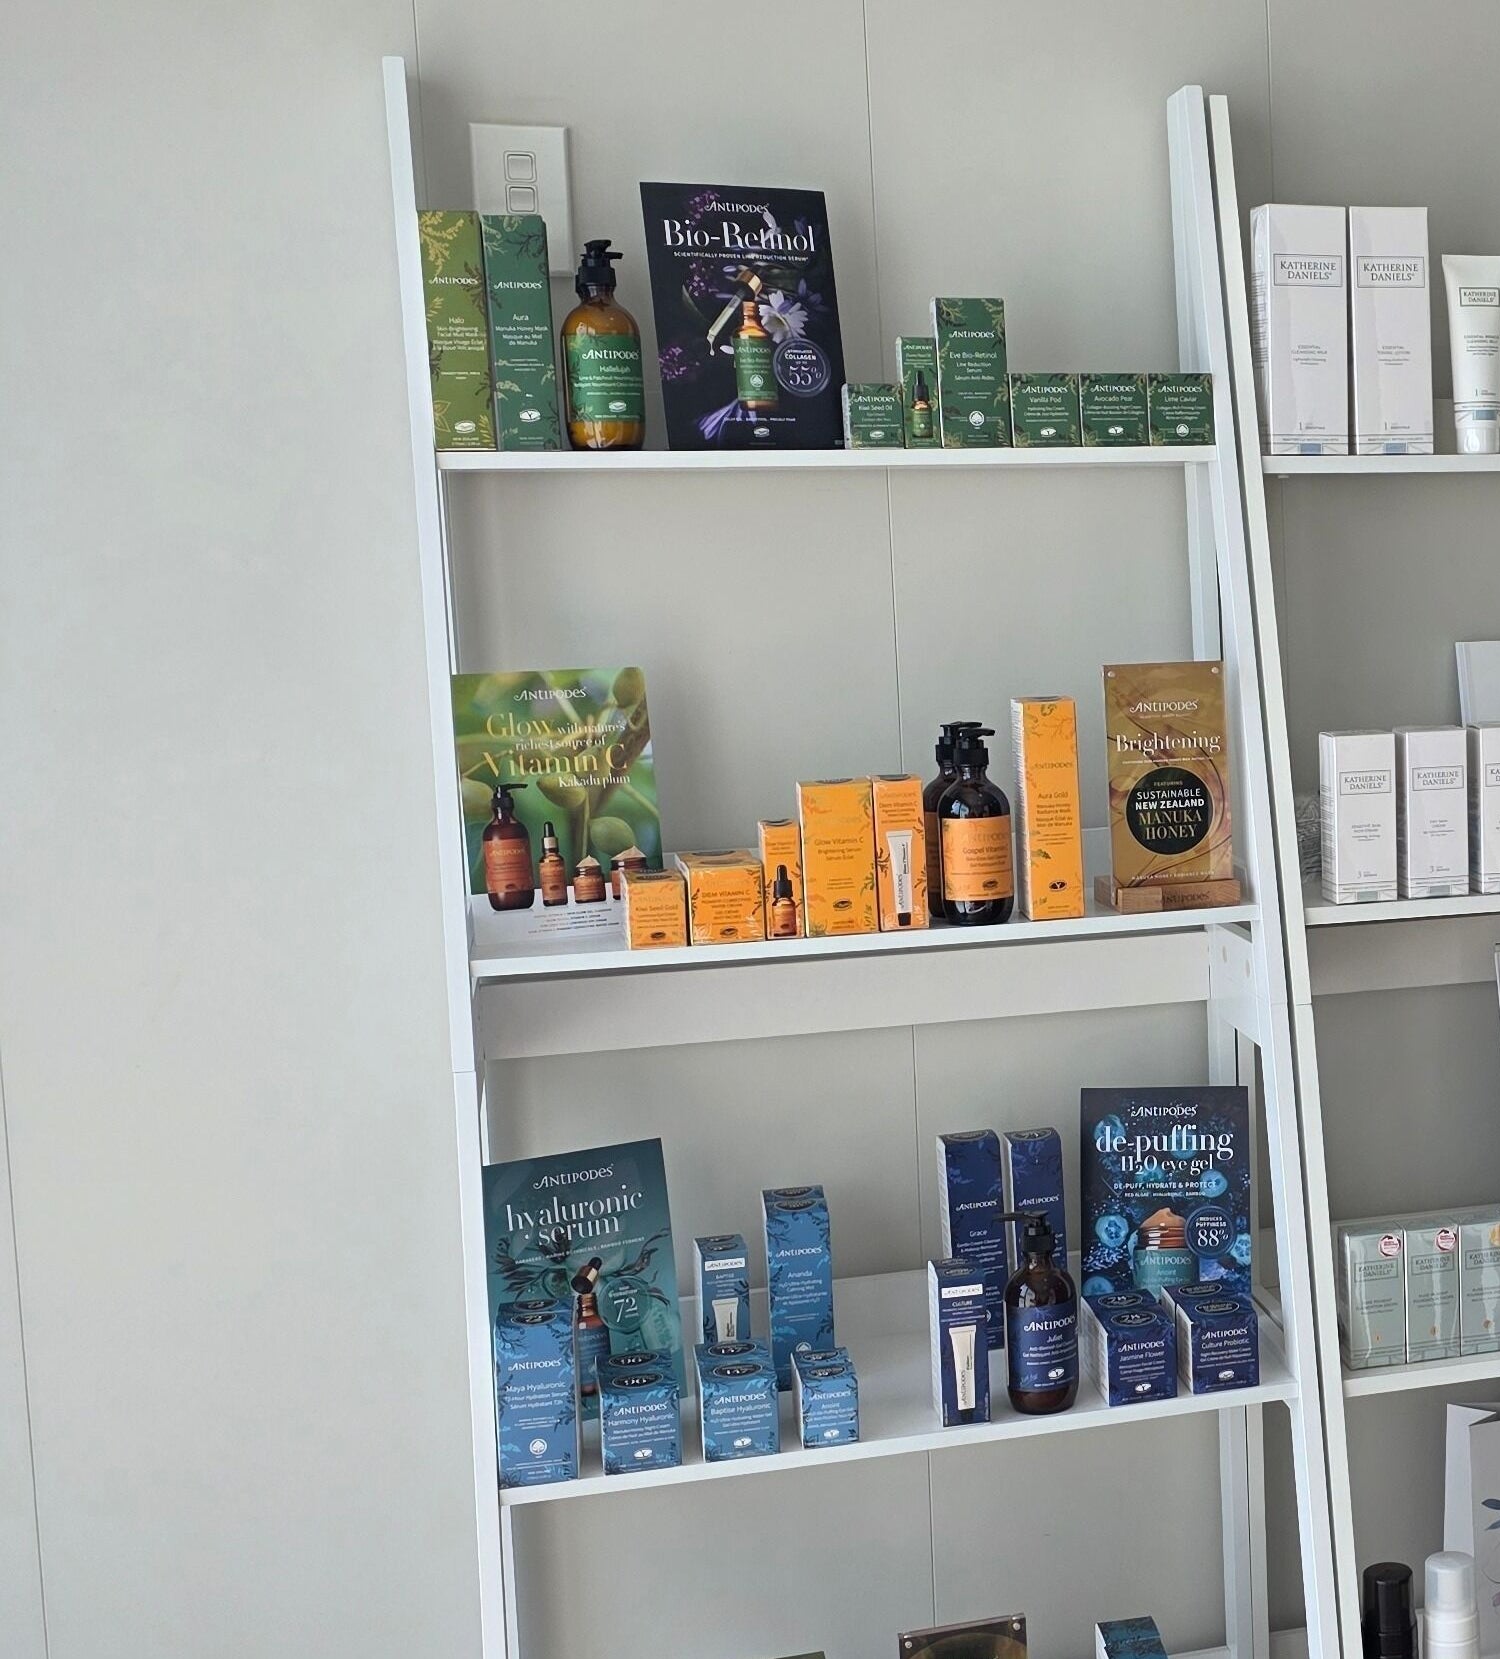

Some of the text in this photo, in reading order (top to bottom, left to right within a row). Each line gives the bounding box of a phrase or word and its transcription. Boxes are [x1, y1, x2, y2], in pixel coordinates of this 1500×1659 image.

[704, 201, 769, 213] ANTIPODES
[662, 219, 816, 252] Bio-Retinol
[1280, 261, 1337, 272] KATHERINE
[1363, 263, 1419, 272] KATHERINE
[429, 276, 479, 285] ANTIPODES
[494, 281, 543, 289] ANTIPODES
[949, 330, 995, 338] ANTIPODES
[784, 353, 817, 361] COLLAGEN
[1022, 386, 1068, 394] ANTIPODES
[1090, 384, 1136, 392] ANTIPODES
[1158, 385, 1202, 393] ANTIPODES
[513, 687, 587, 701] ANTIPODES
[1129, 699, 1199, 713] ANTIPODES
[486, 712, 626, 738] Glow with nature's
[515, 734, 607, 750] richest source of
[1115, 731, 1221, 758] Brightening
[483, 743, 628, 777] Vitamin C
[558, 773, 631, 789] Kakadu plum
[1344, 775, 1387, 784] KATHERINE
[1417, 771, 1459, 779] KATHERINE
[1136, 788, 1201, 800] SUSTAINABLE
[1135, 798, 1205, 811] NEW ZEALAND
[1138, 809, 1203, 827] MANUKA
[1144, 824, 1198, 841] HONEY
[814, 836, 864, 846] Glow Vitamin C
[1130, 1105, 1198, 1117] ANTIPODES
[1095, 1124, 1234, 1161] de-puffing
[1161, 1159, 1188, 1175] eye
[1190, 1153, 1214, 1176] gel
[533, 1163, 614, 1190] ANTIPODES
[1113, 1182, 1145, 1190] DE-PUFF,
[1185, 1181, 1217, 1189] PROTECT
[955, 1199, 997, 1211] ANTIPODES
[1018, 1195, 1060, 1207] ANTIPODES
[506, 1184, 642, 1240] hyaluronic
[538, 1216, 620, 1245] serum
[969, 1229, 988, 1237] Grace
[1197, 1228, 1229, 1247] 88%
[776, 1245, 823, 1257] ANTIPODES
[787, 1270, 813, 1278] Ananda
[1358, 1264, 1395, 1273] KATHERINE
[613, 1297, 638, 1323] 72
[1046, 1334, 1063, 1343] Juliet
[1202, 1326, 1248, 1340] ANTIPODES
[1118, 1339, 1165, 1352] ANTIPODES
[1201, 1338, 1250, 1349] Culture Probiotic
[1119, 1350, 1164, 1362] Jasmine Flower
[507, 1357, 562, 1372] ANTIPODES
[506, 1381, 566, 1393] Maya Hyaluronic
[713, 1391, 768, 1405] ANTIPODES
[809, 1390, 850, 1400] ANTIPODES
[613, 1402, 668, 1416] ANTIPODES
[710, 1403, 771, 1415] Baptise Hyaluronic
[608, 1413, 675, 1427] Harmony Hyaluronic
